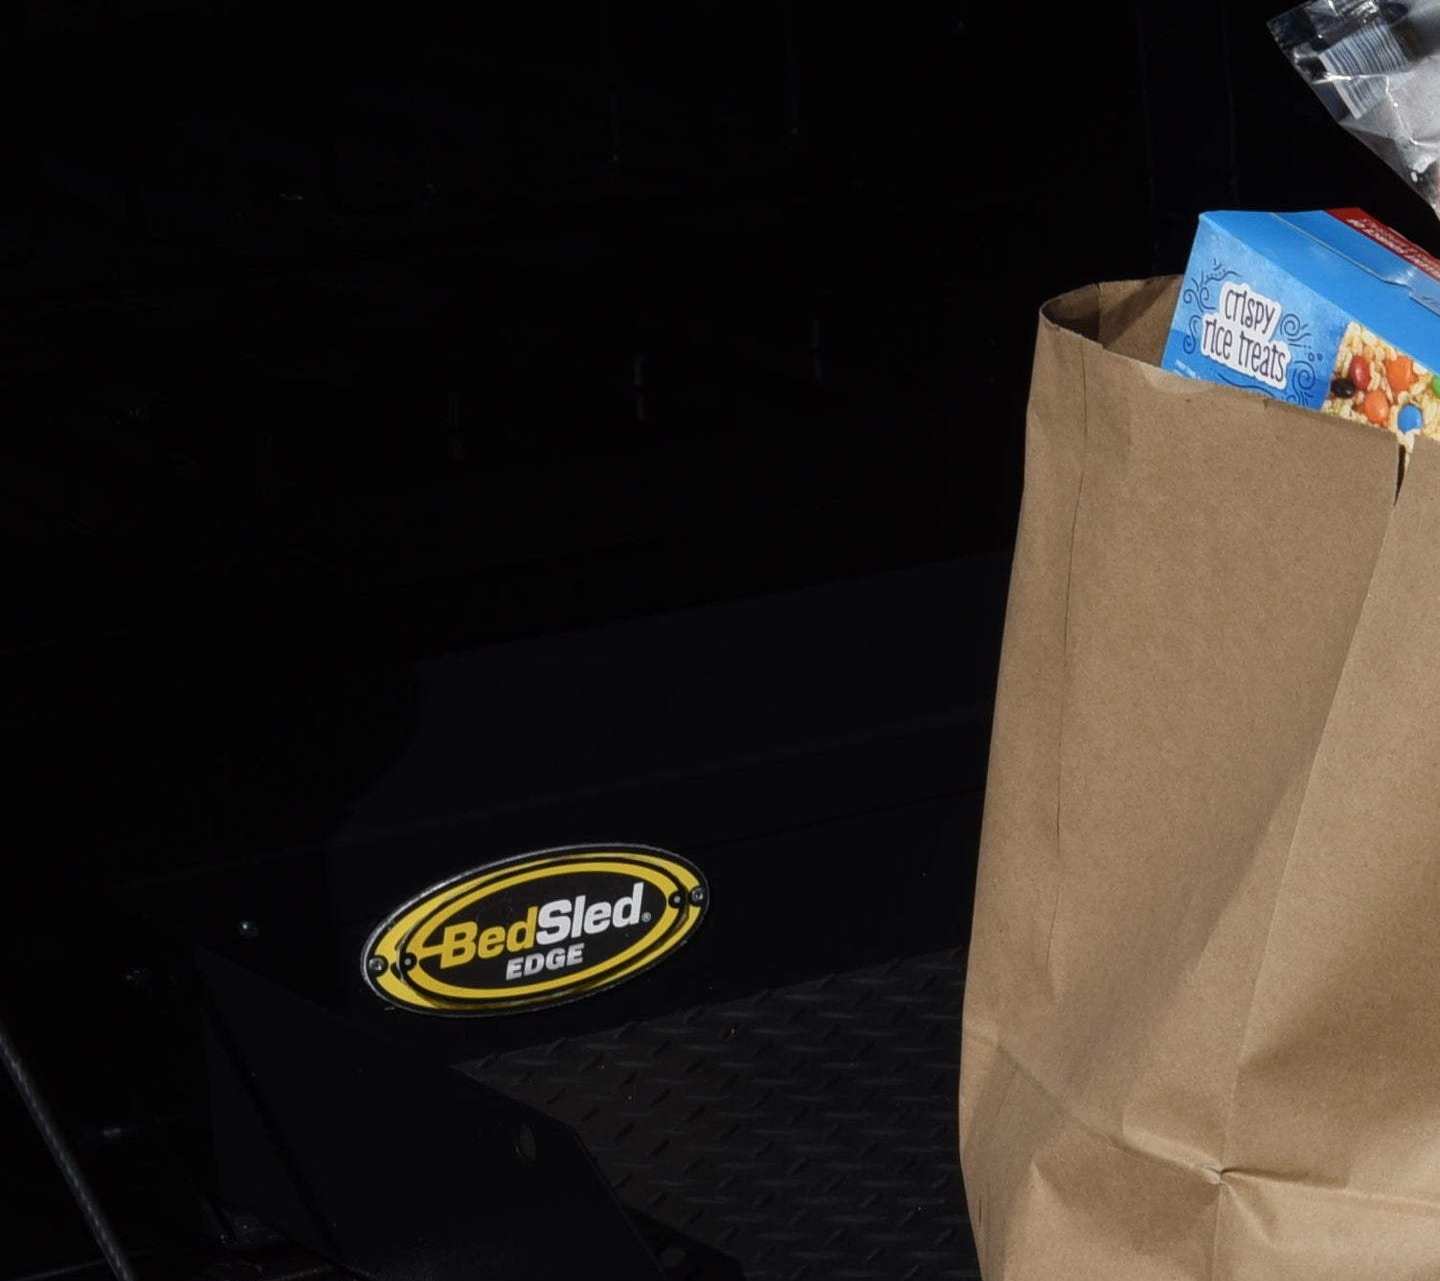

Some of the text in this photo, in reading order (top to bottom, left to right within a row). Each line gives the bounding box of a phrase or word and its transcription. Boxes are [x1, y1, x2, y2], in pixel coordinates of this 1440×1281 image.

[1224, 289, 1276, 335] crispy
[1203, 318, 1233, 360] rice
[1237, 330, 1286, 383] treats
[440, 881, 644, 969] BedSled
[505, 941, 585, 981] EDGE
